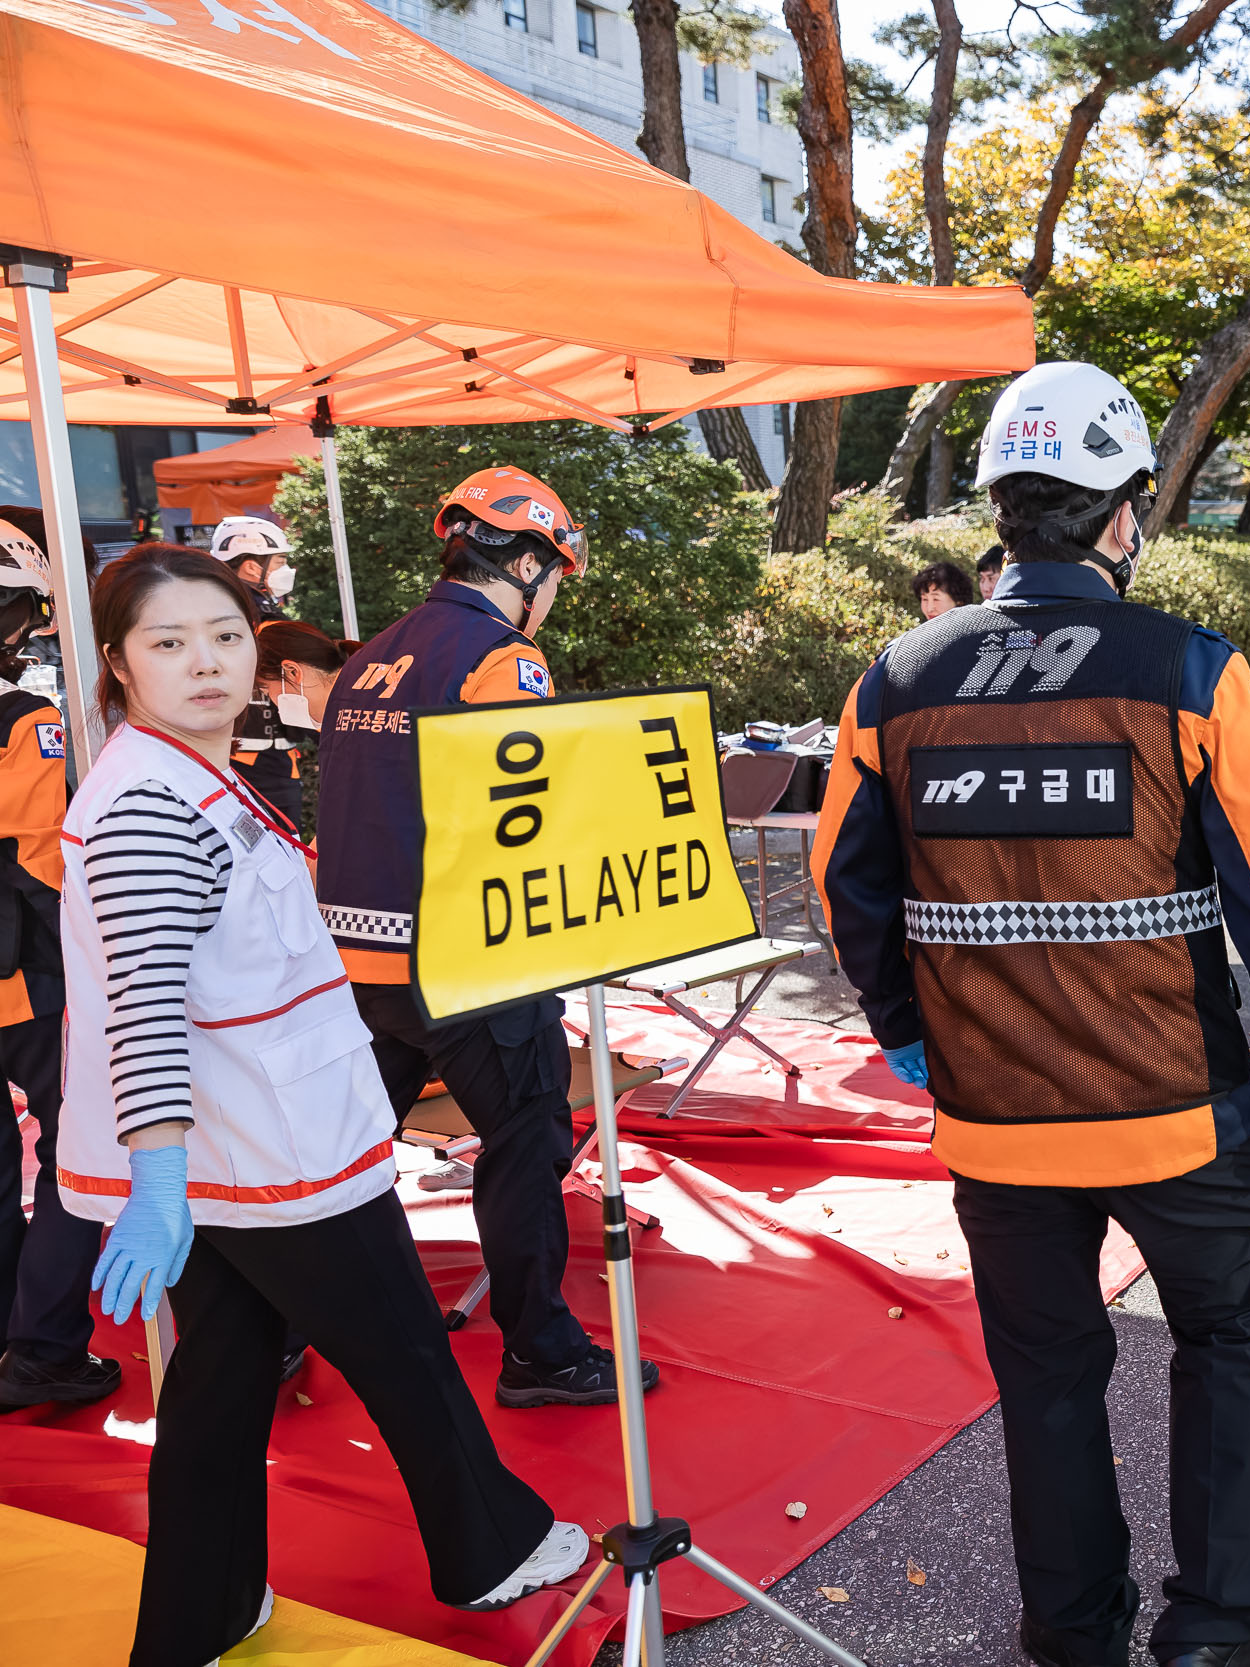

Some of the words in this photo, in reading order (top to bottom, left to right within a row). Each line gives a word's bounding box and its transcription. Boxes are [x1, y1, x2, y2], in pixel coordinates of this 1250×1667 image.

[1006, 420, 1057, 438] EMS
[1000, 440, 1062, 460] 구급대
[464, 486, 489, 500] FIRE
[352, 654, 414, 699] 119
[956, 625, 1101, 697] 119
[921, 770, 986, 803] 119
[482, 838, 711, 948] DELAYED
